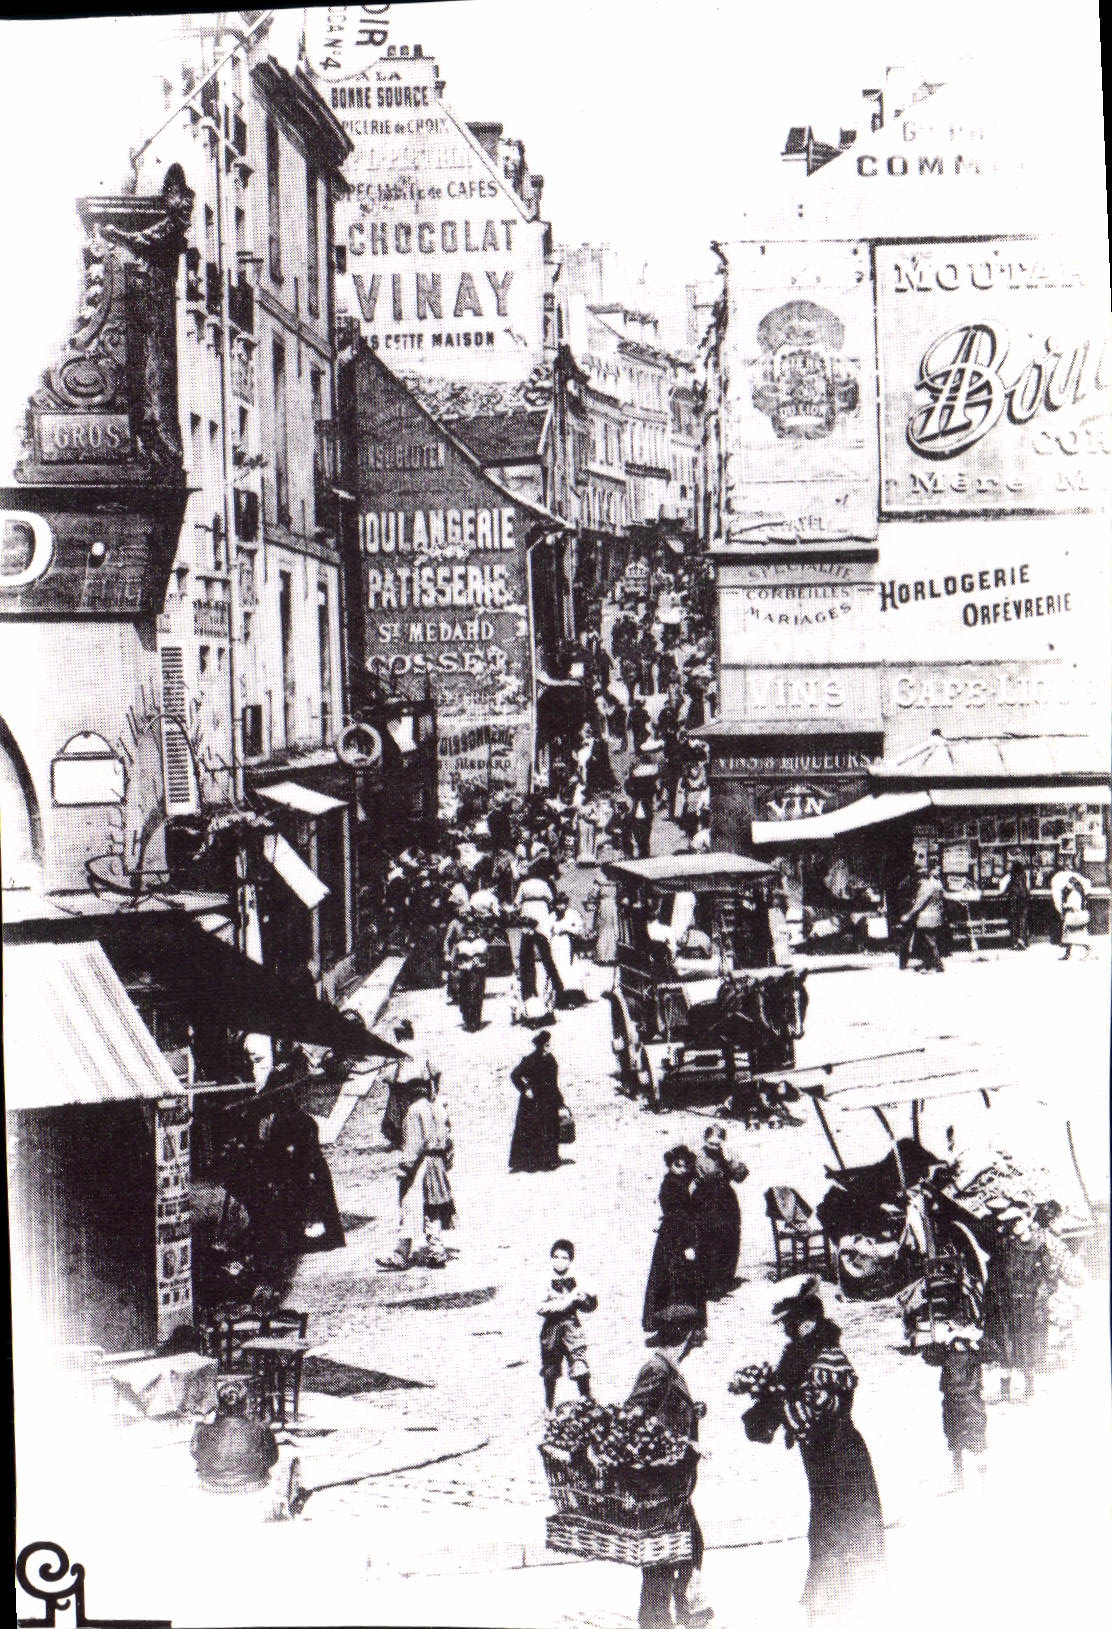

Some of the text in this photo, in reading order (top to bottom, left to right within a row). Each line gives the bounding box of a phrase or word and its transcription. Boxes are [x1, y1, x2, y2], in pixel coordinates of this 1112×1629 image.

[331, 85, 430, 109] BONNE SOURCE
[348, 218, 518, 257] CHOCOLAT
[351, 269, 515, 323] VINAY
[431, 330, 495, 348] MAISON
[357, 506, 517, 554] OULANGERIE
[879, 563, 1031, 613] HORLOGERIE
[746, 601, 852, 627] MARIAGES
[751, 674, 845, 709] VINS
[767, 797, 827, 820] VIN
